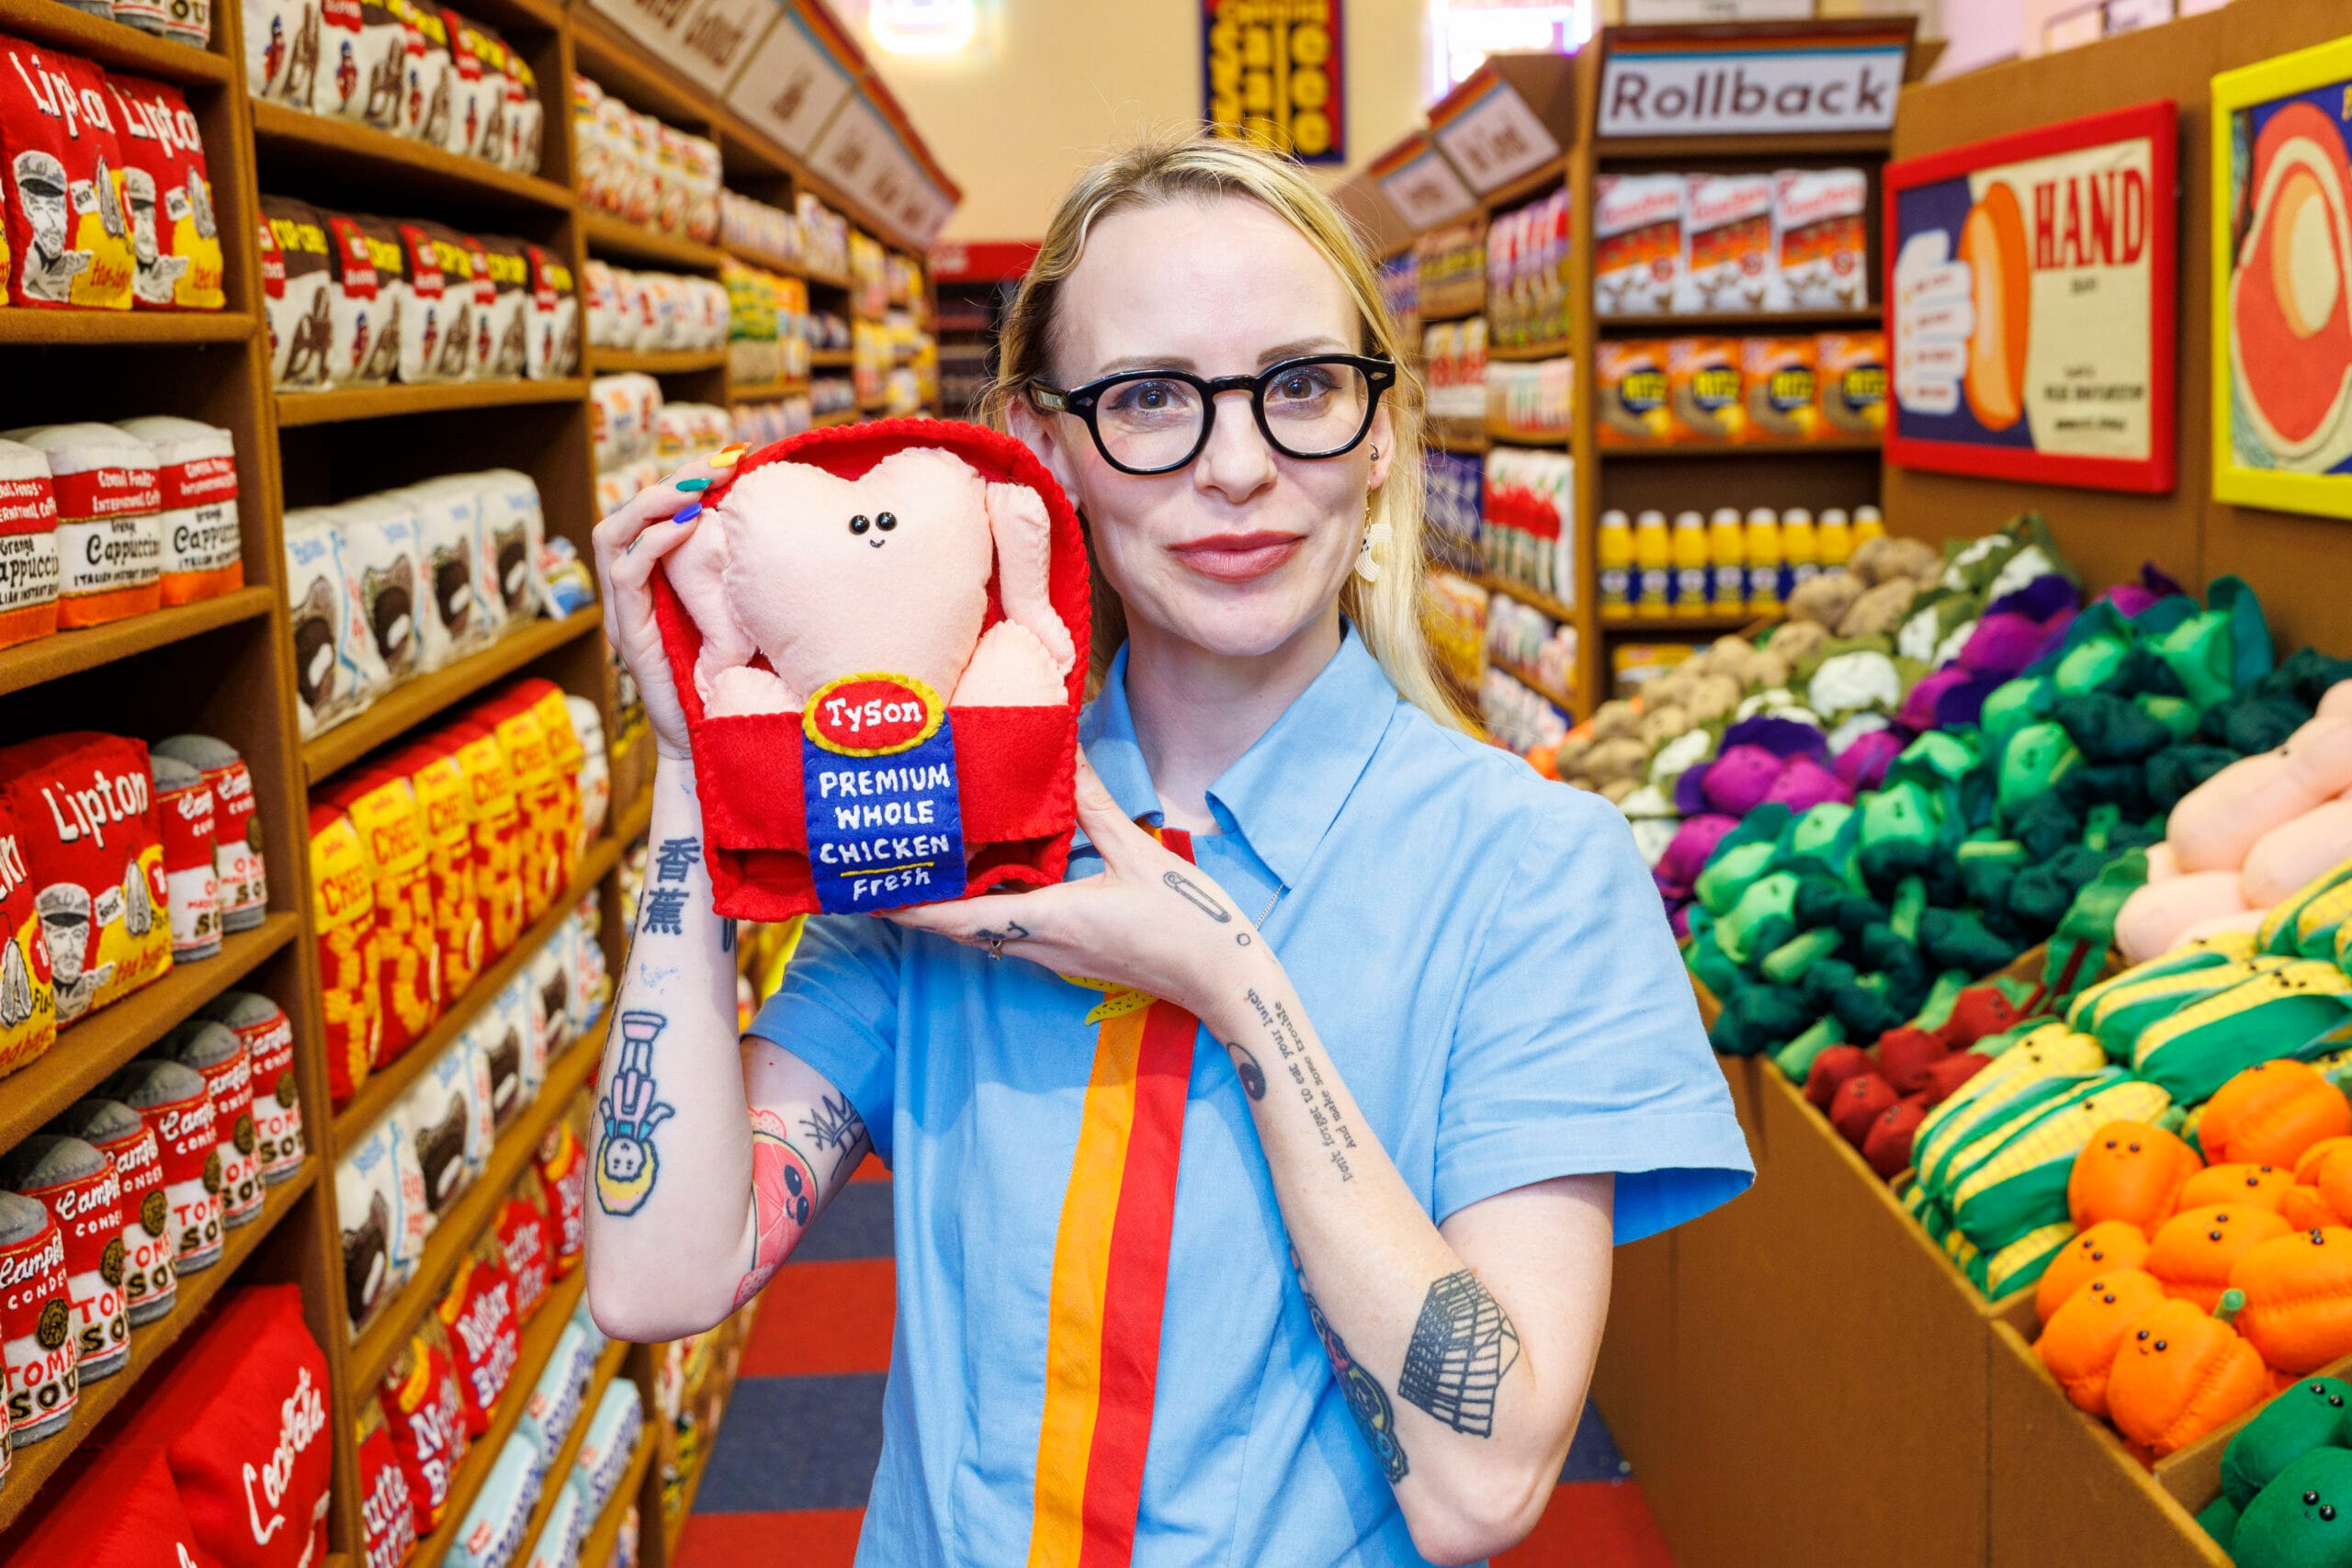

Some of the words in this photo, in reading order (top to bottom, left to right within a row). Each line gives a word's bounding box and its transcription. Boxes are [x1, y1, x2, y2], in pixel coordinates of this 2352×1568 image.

[1611, 65, 1887, 120] Rollback
[106, 82, 202, 160] Lipto
[2031, 166, 2146, 271] HAND
[825, 697, 922, 732] Tyson
[820, 763, 950, 797] PREMIUM
[41, 770, 149, 849] Lipton
[834, 799, 934, 829] WHOLE
[820, 834, 949, 864] CHICKEN
[642, 837, 700, 935] 香蕉
[853, 867, 931, 901] Fresh
[1246, 987, 1273, 1027] lunch
[1274, 1000, 1306, 1053] trouble
[1272, 1029, 1295, 1060] your
[1288, 1063, 1305, 1085] eat
[1303, 1055, 1324, 1087] some
[1300, 1088, 1314, 1103] to
[1320, 1089, 1341, 1122] make
[1309, 1105, 1334, 1147] forget
[1335, 1124, 1357, 1149] And
